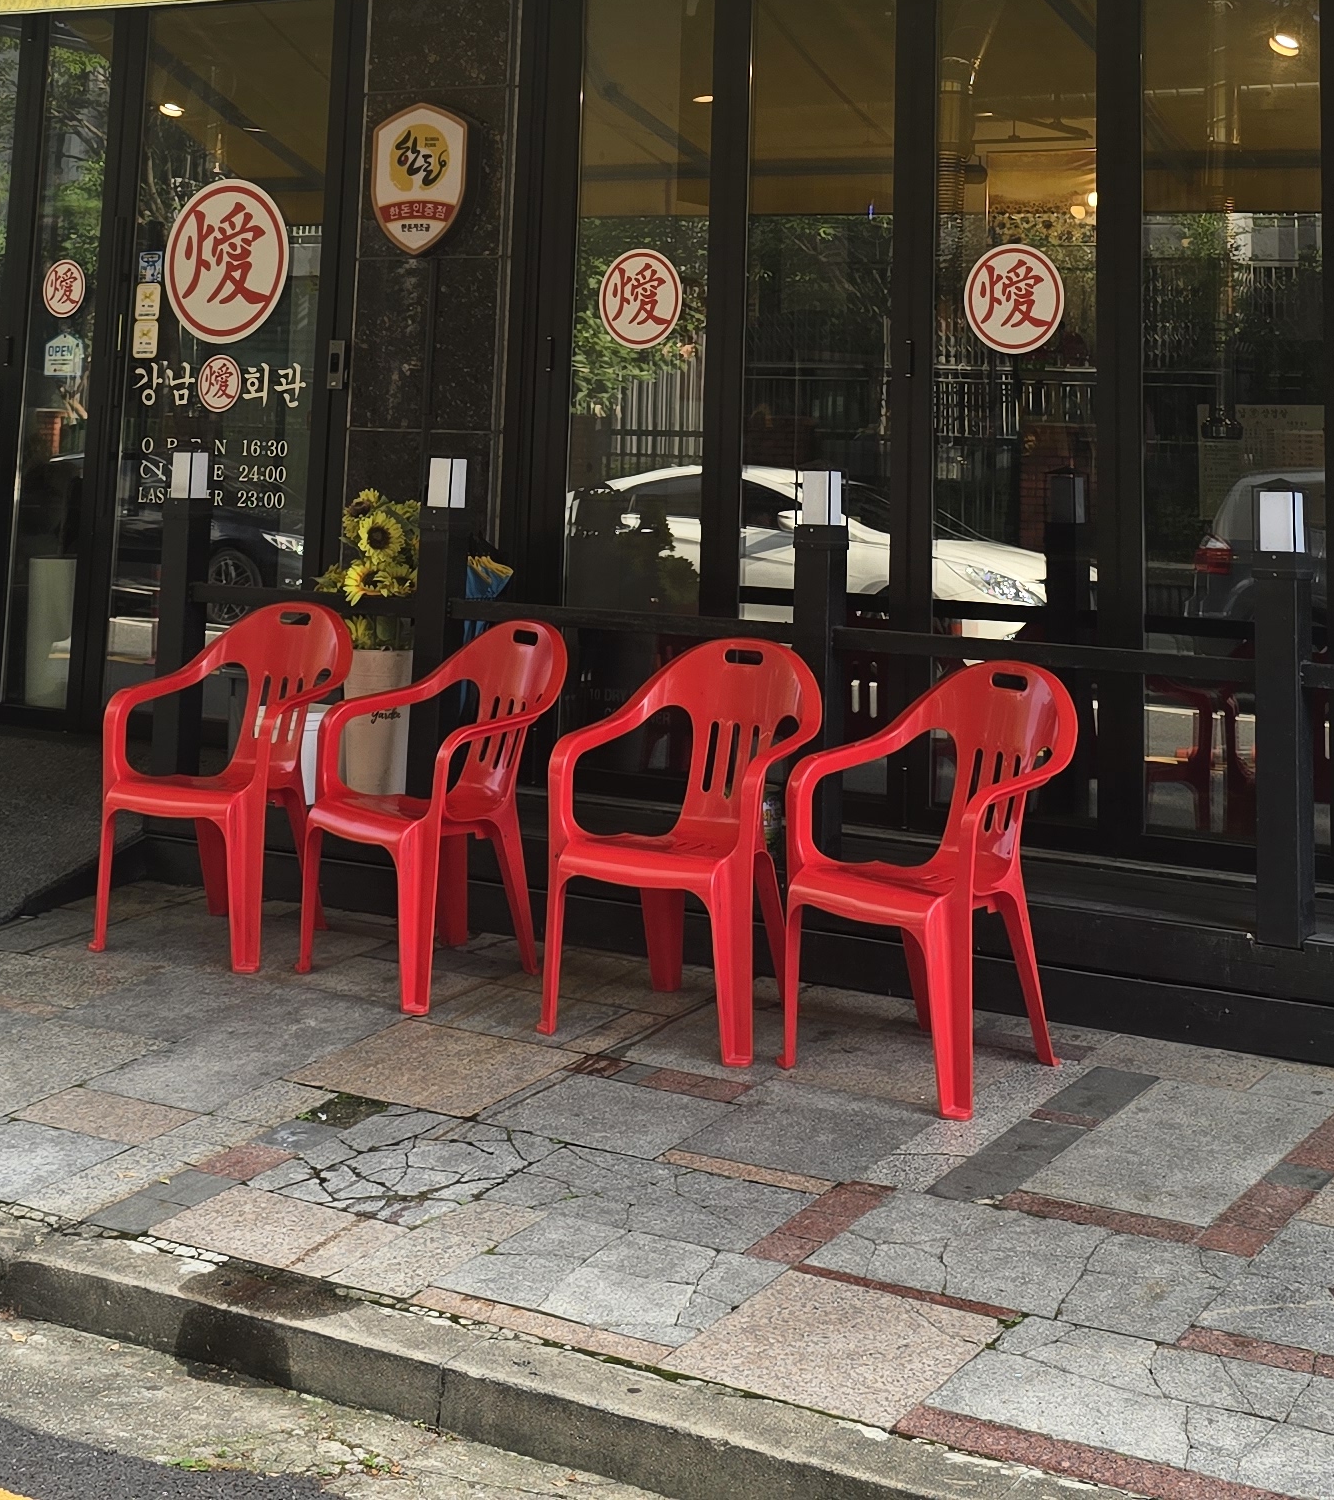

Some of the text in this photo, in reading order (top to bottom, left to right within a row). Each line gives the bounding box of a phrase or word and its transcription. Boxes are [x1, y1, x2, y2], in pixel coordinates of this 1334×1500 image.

[389, 203, 446, 219] 한돈인증점
[48, 345, 73, 357] OPEN
[133, 361, 196, 407] 강남
[242, 362, 307, 409] 회관
[242, 439, 288, 457] 16:30
[239, 465, 287, 483] 24:00
[237, 490, 285, 509] 23:00
